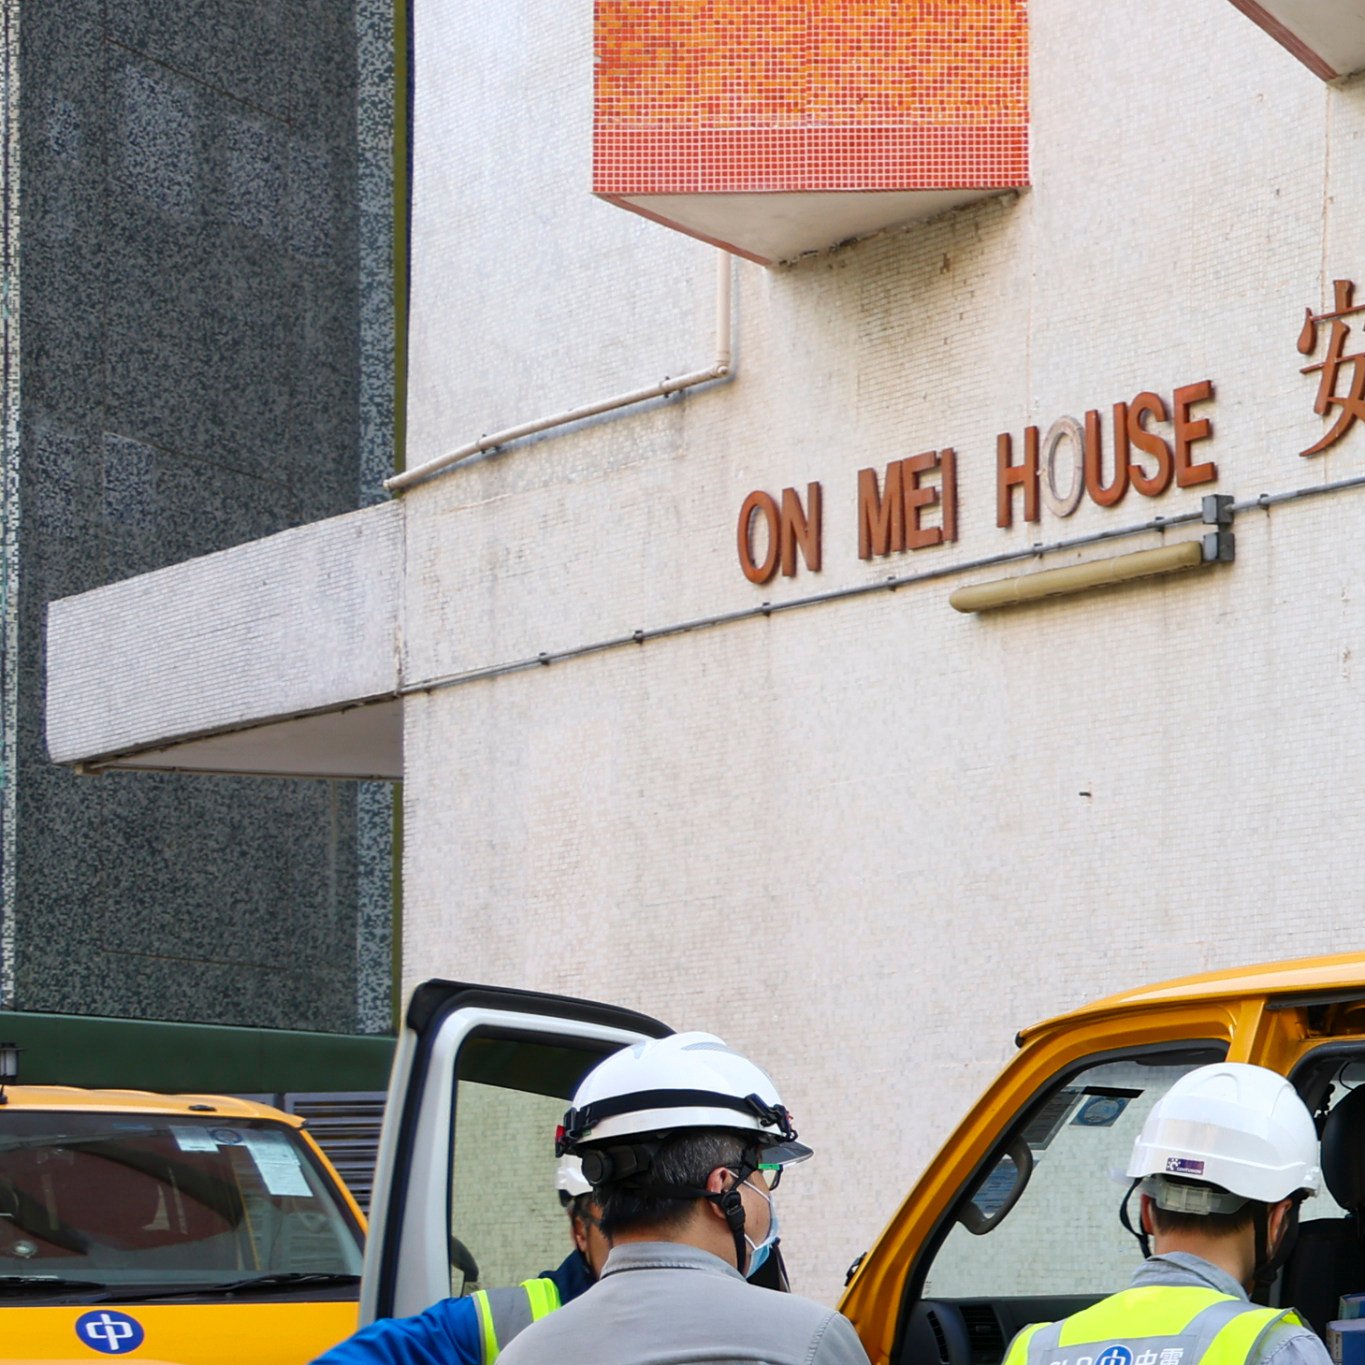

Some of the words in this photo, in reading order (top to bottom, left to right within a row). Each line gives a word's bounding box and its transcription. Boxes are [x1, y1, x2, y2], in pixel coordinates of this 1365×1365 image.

[736, 481, 822, 585] ON
[857, 446, 958, 560] MEI
[995, 379, 1217, 529] HOUSE
